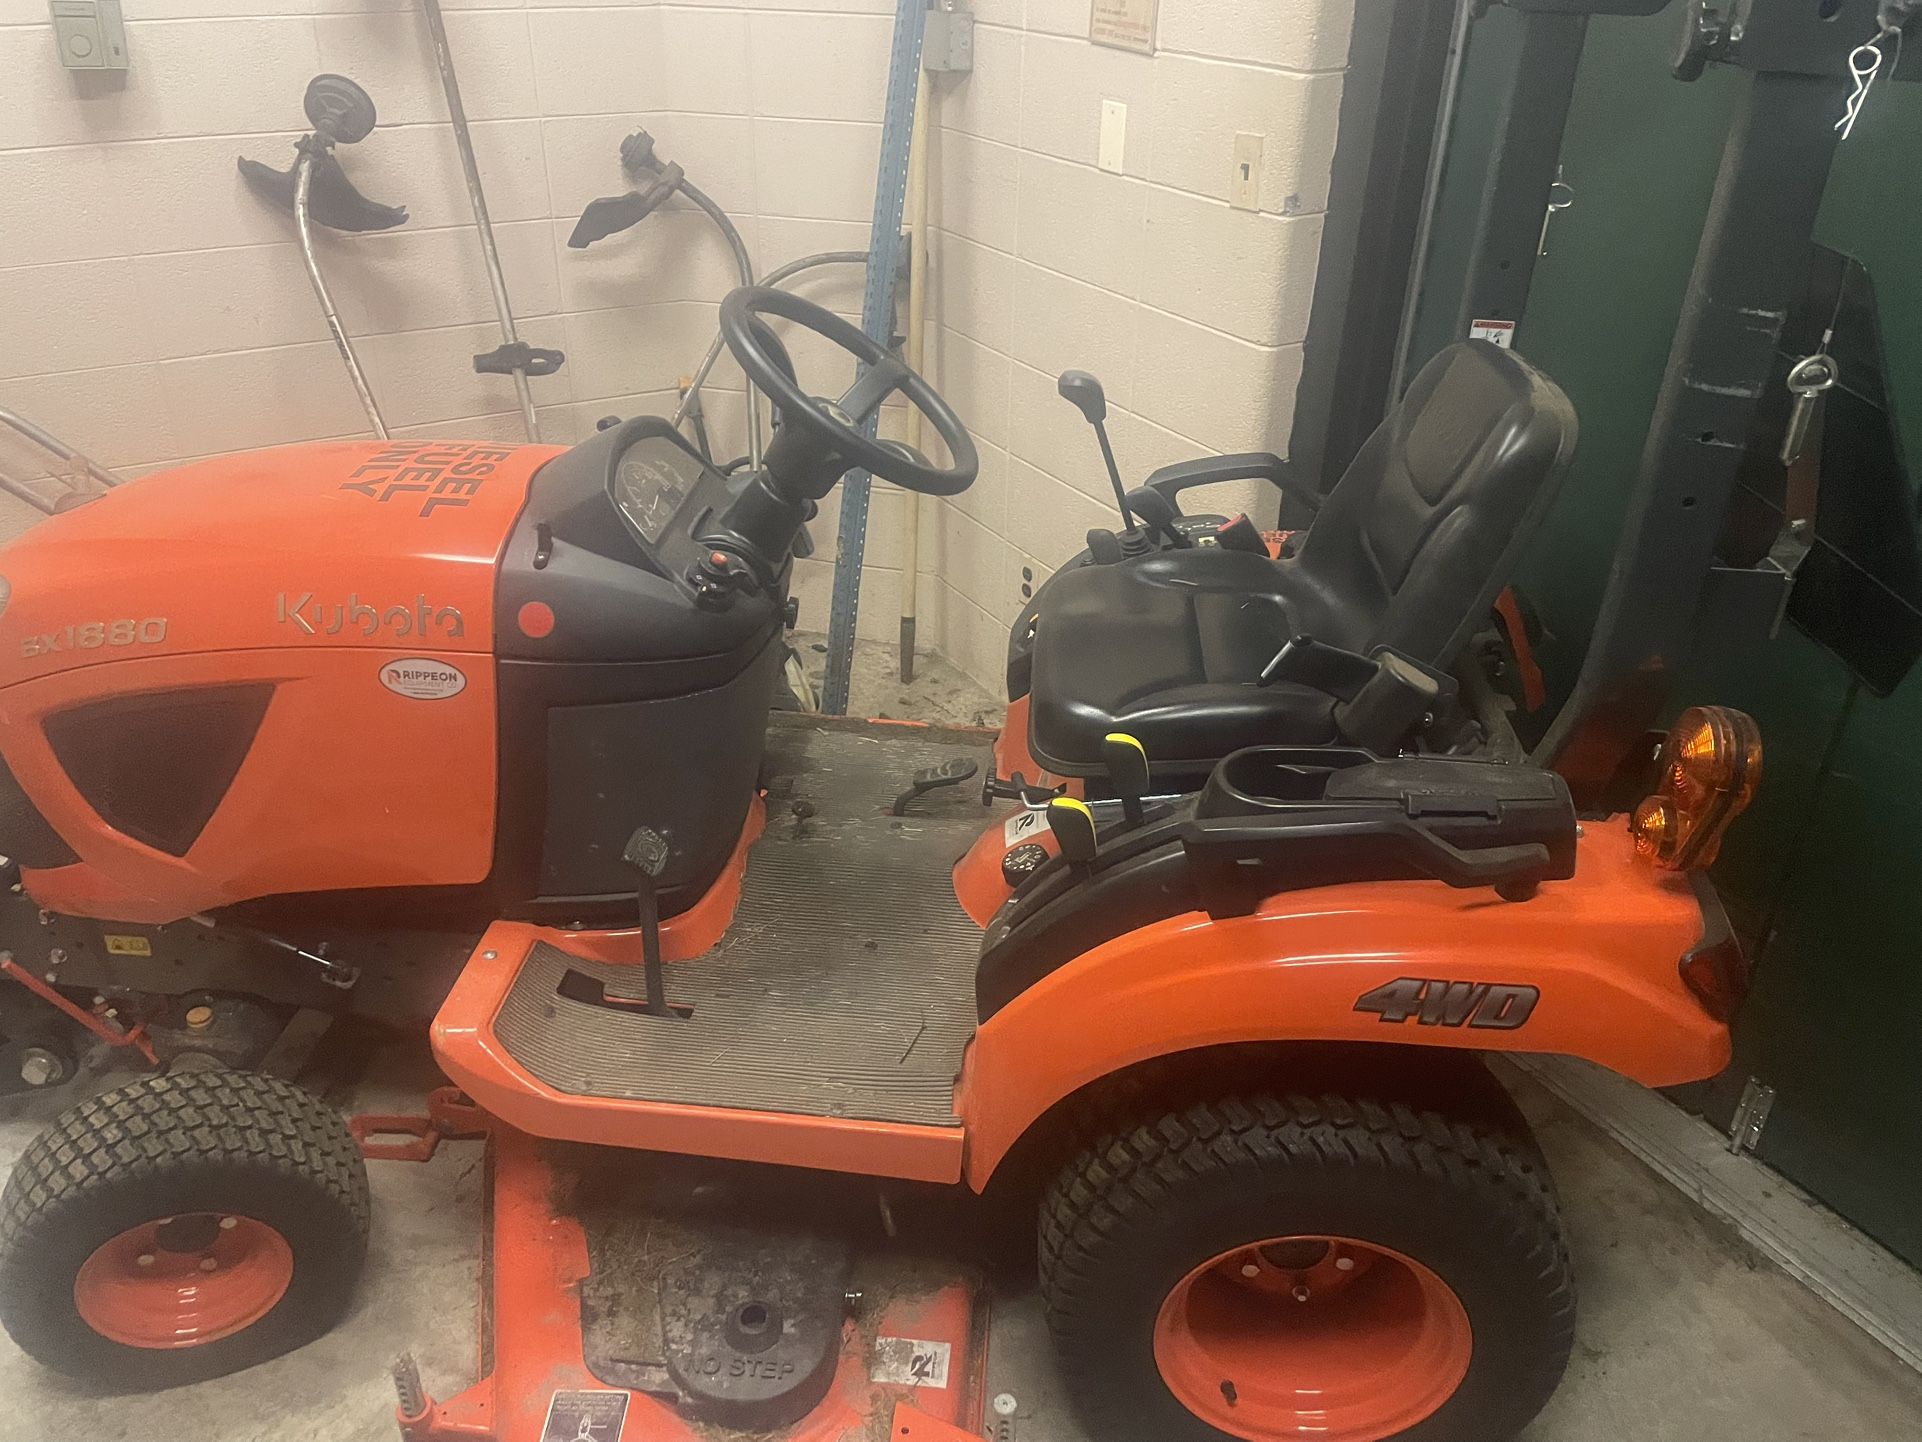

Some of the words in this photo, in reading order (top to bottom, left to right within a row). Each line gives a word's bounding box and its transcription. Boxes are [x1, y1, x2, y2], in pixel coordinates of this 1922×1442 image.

[338, 441, 434, 498] ONLY
[377, 443, 475, 502] FUEL
[419, 442, 519, 518] IESEL
[277, 592, 465, 638] Kubota
[403, 670, 457, 682] RIPPEON
[1353, 976, 1541, 1031] 4WD
[682, 1357, 721, 1376] NO
[728, 1359, 795, 1381] STEP
